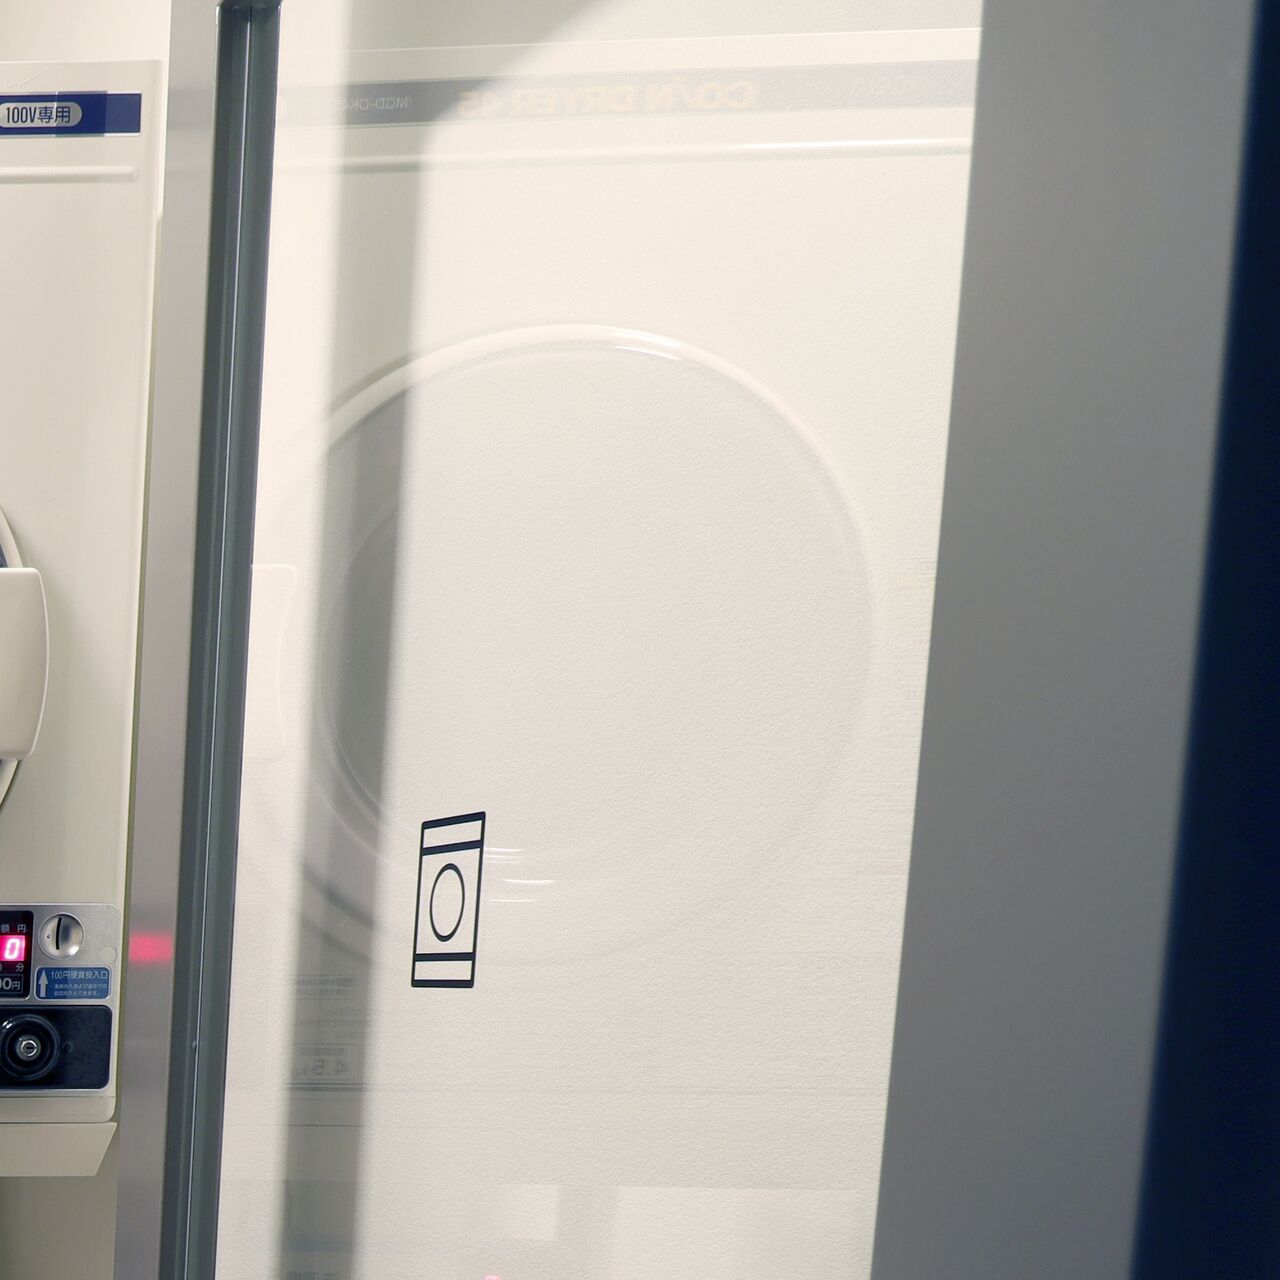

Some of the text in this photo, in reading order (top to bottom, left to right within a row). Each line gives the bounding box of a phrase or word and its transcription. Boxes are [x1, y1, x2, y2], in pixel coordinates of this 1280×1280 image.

[4, 104, 72, 126] 100V専用
[17, 924, 27, 933] 円
[4, 938, 21, 959] 0
[15, 964, 25, 973] 分
